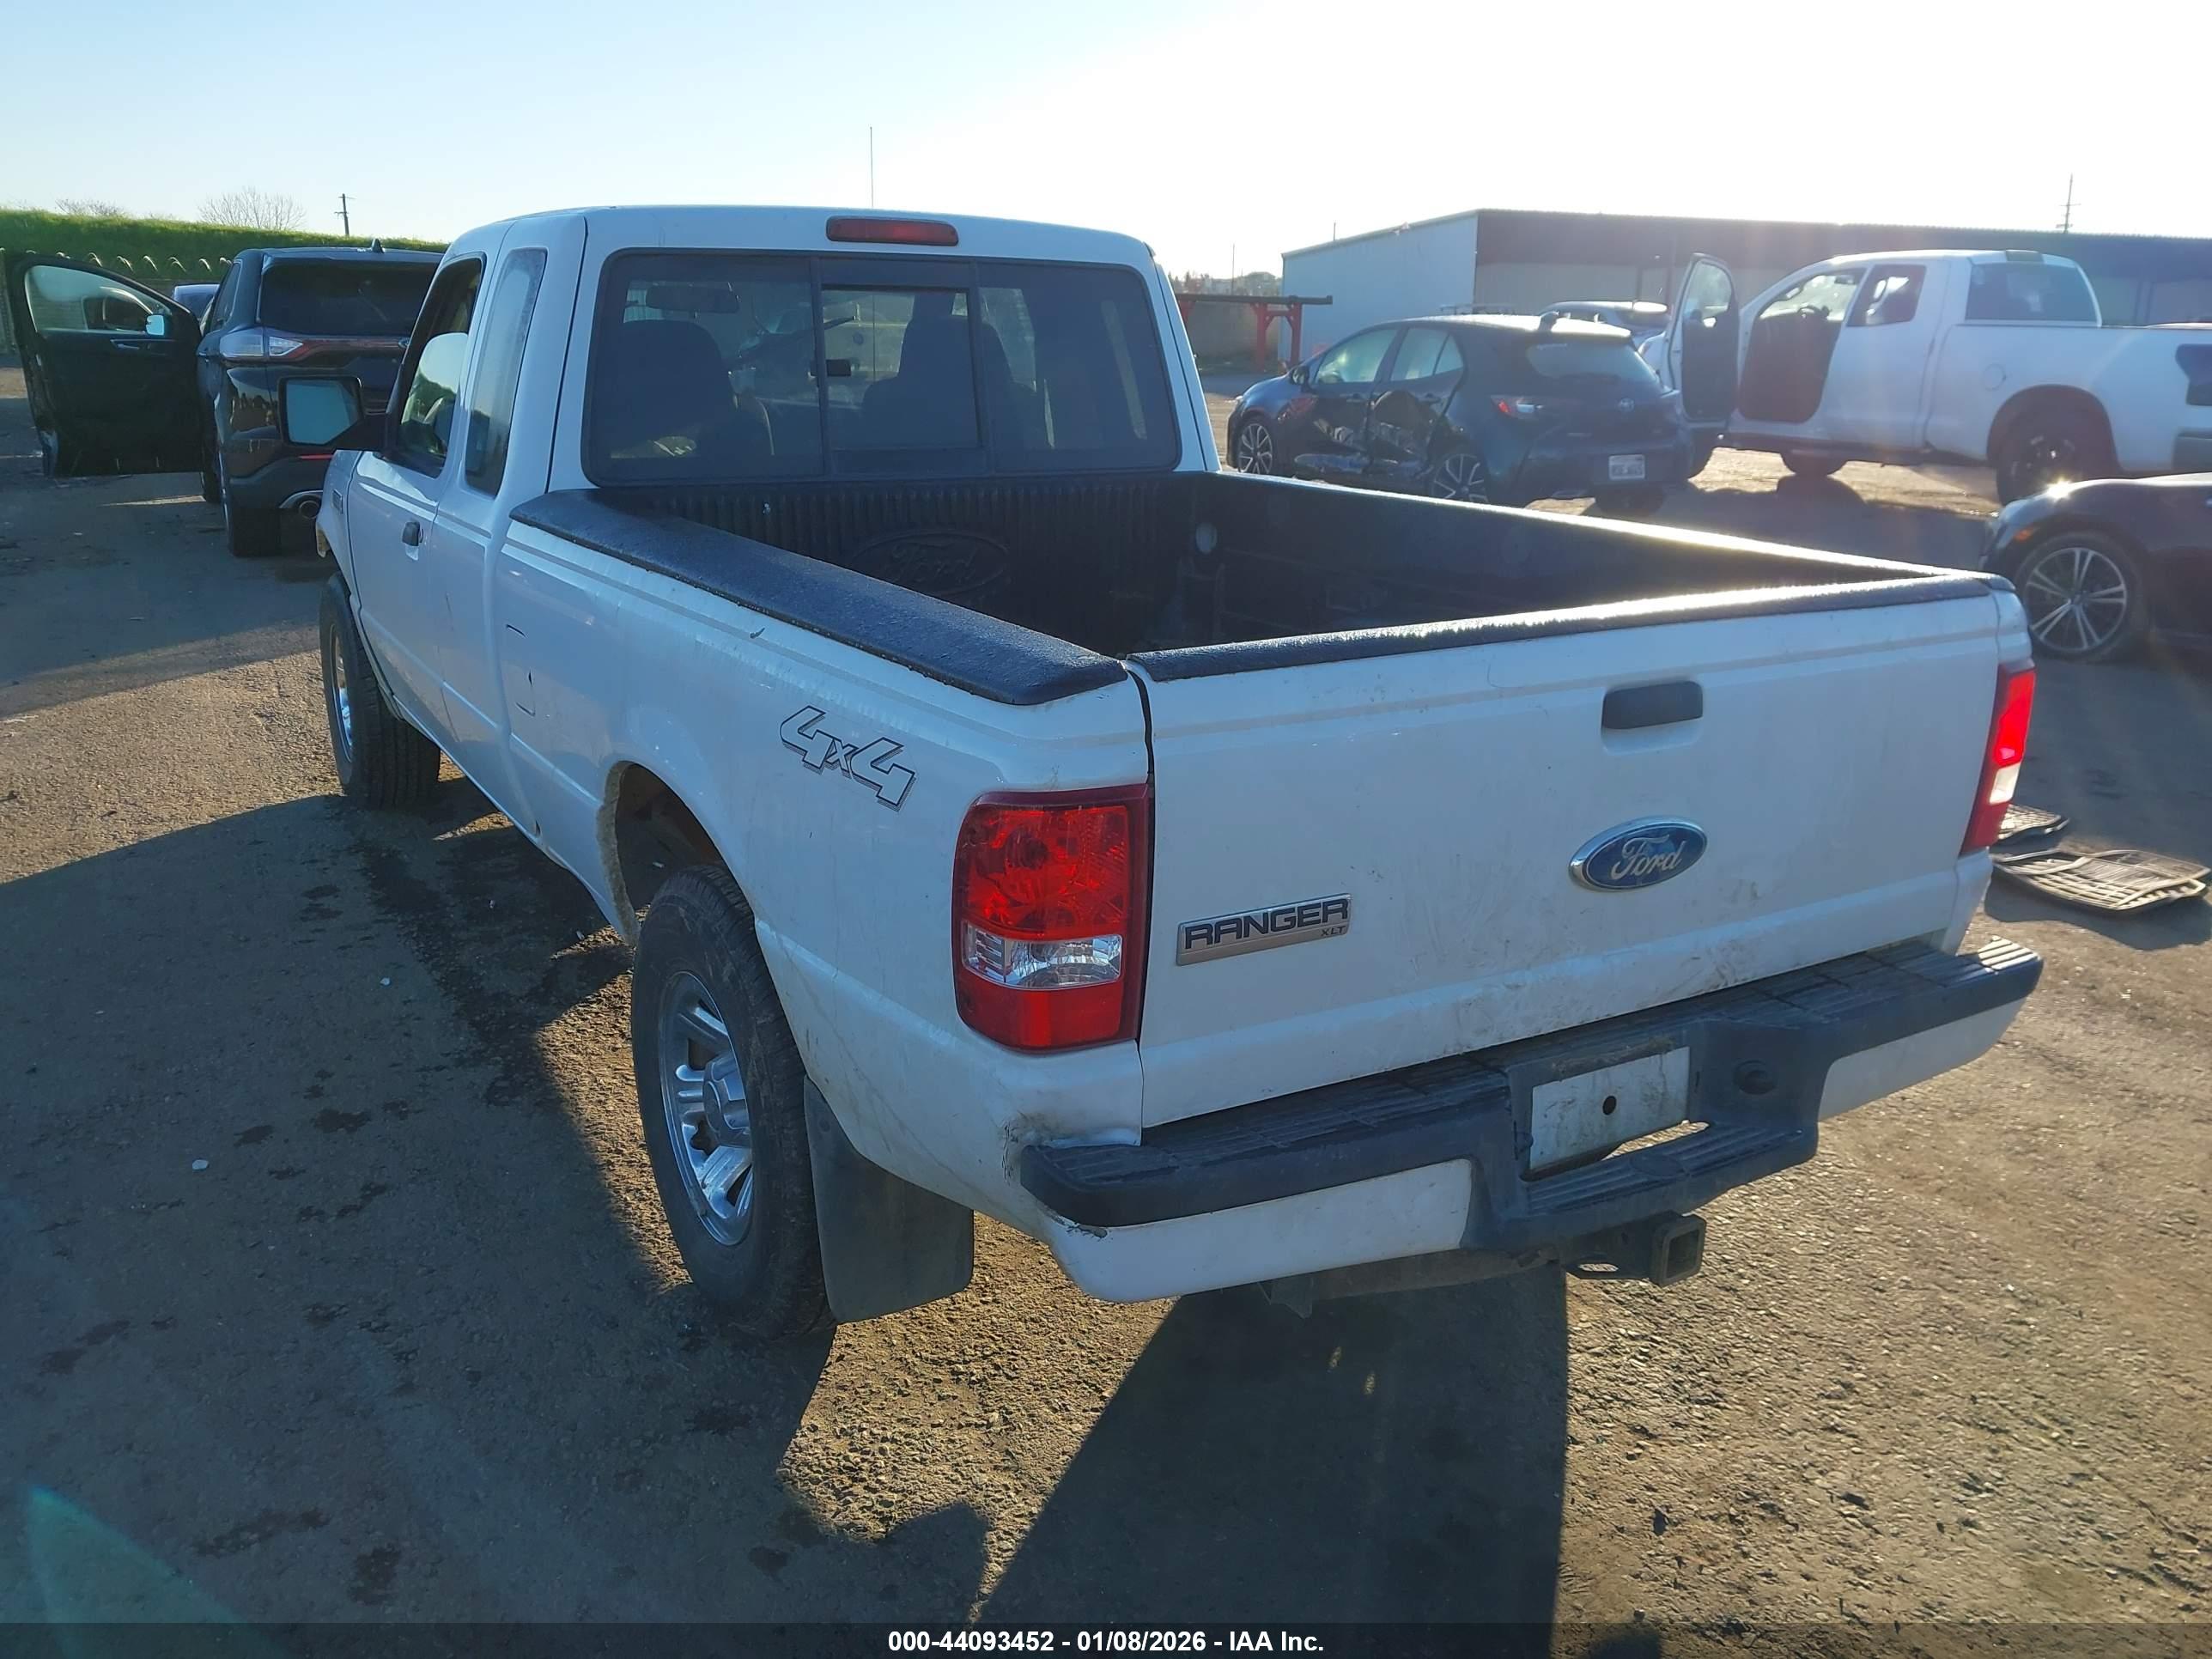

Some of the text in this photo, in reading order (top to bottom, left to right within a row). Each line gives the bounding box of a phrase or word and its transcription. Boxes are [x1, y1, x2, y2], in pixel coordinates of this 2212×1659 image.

[883, 539, 977, 584] Ford
[1611, 833, 1686, 880] Ford
[1184, 898, 1349, 949] RANGER
[1321, 925, 1346, 937] XLT
